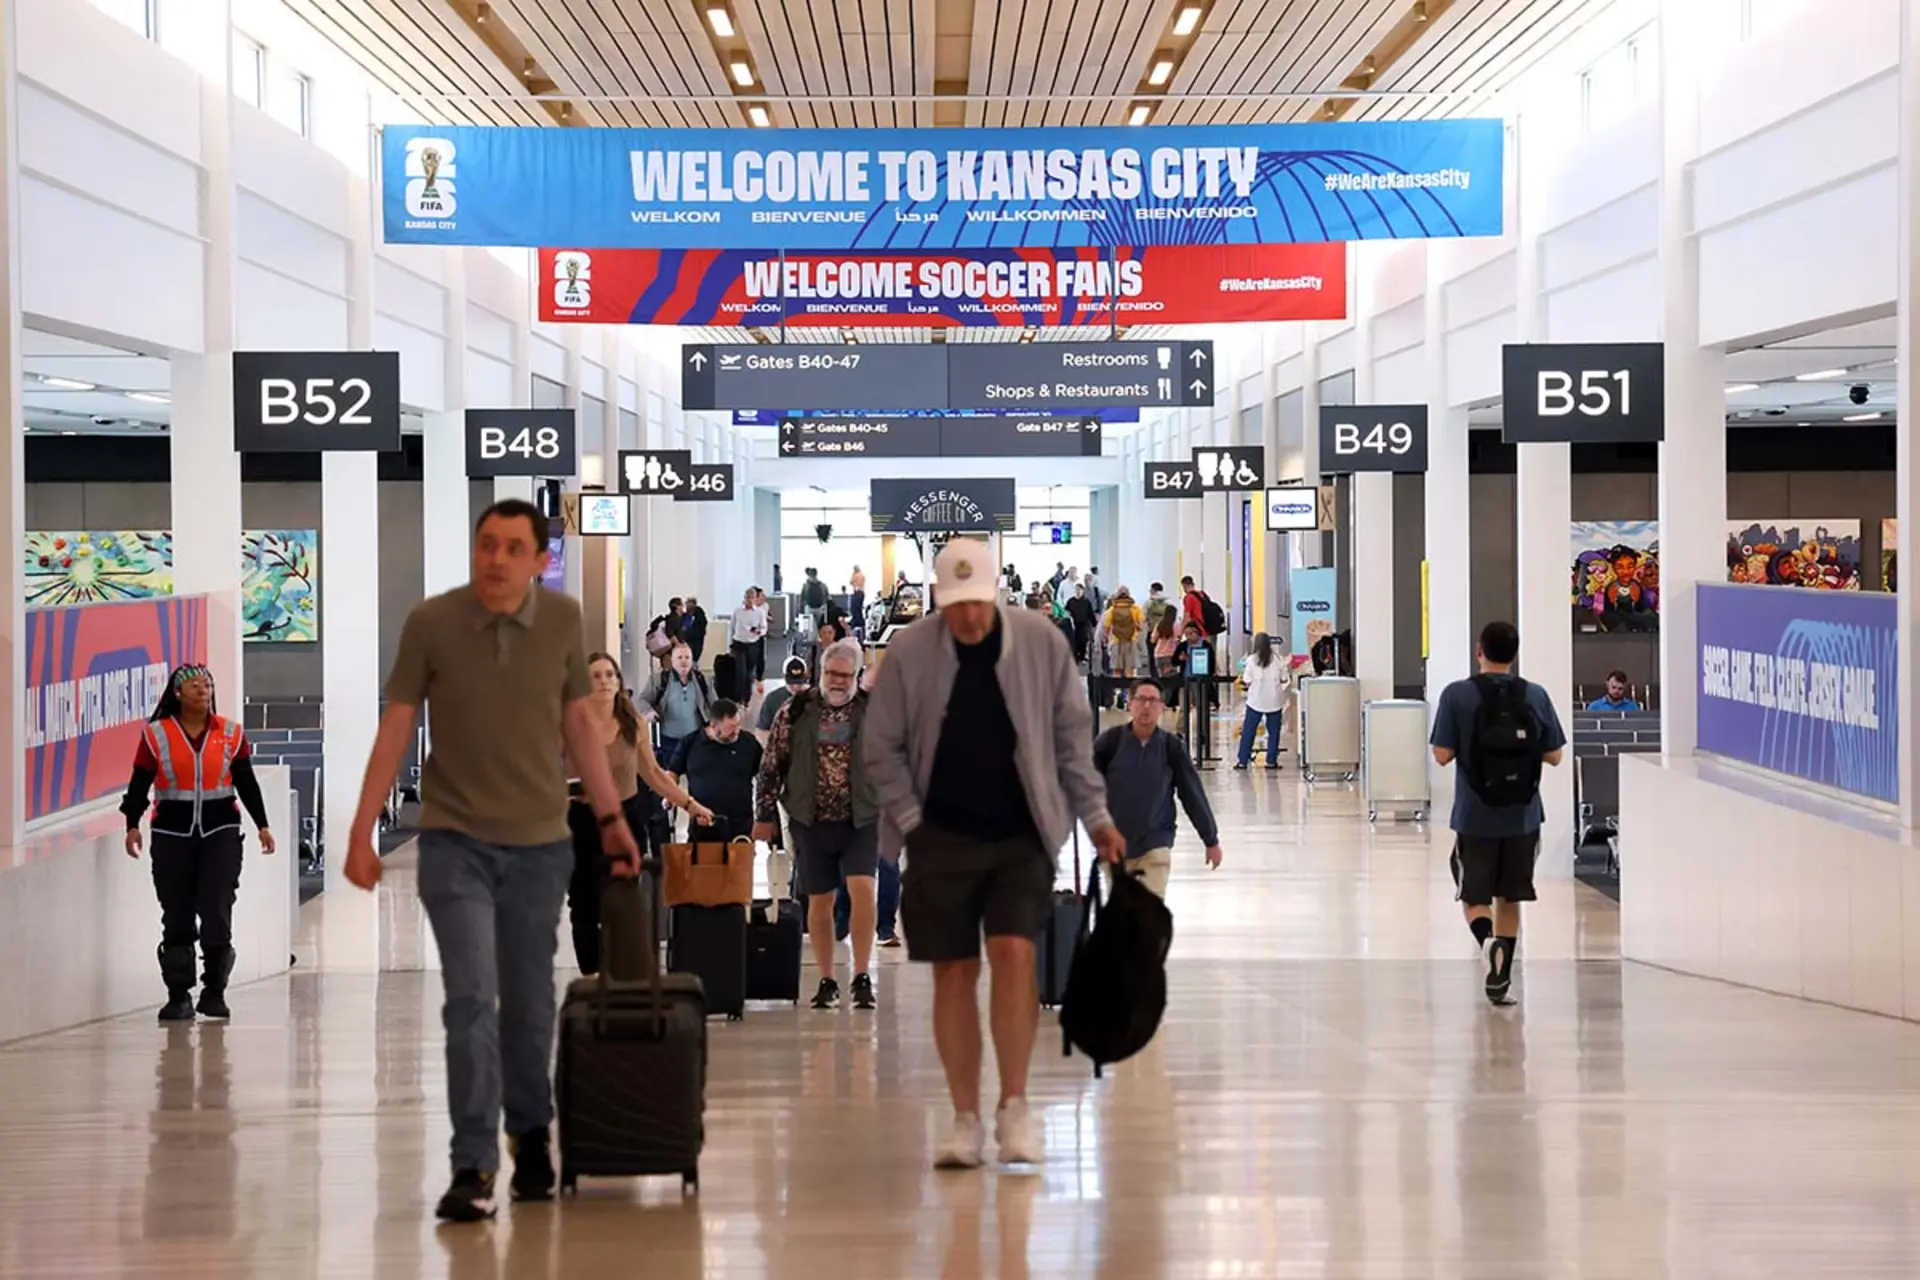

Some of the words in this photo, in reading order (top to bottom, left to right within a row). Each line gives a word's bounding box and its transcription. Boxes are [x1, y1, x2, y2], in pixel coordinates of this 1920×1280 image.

[630, 151, 870, 202] WELCOME
[879, 151, 937, 202] TO
[947, 149, 1142, 201] KANSAS
[1151, 147, 1259, 199] CITY
[1324, 168, 1471, 191] #WeAreKansasCity
[420, 201, 443, 211] FIFA
[966, 209, 1107, 222] WILLKOMMEN
[1135, 207, 1258, 220] BIENVENIDO
[631, 211, 721, 223] WELKOM
[752, 211, 866, 223] BIENVENUE
[743, 262, 913, 298] WELCOME
[919, 261, 1050, 298] SOCCER
[1057, 260, 1143, 297] FANS
[1219, 275, 1323, 292] #WeAreKansasCity
[806, 303, 887, 313] BIENVENUE
[958, 303, 1057, 313] WILLKOMMEN
[1077, 301, 1164, 312] BIENVENIDO
[746, 355, 794, 369] Gates
[799, 355, 860, 369] B40-47
[1063, 352, 1149, 367] Restrooms
[985, 384, 1035, 400] Shops
[1039, 383, 1051, 398] &
[1055, 383, 1149, 397] Restaurants
[1538, 369, 1630, 416] B51
[261, 378, 372, 425] B52
[817, 423, 847, 433] Gates
[849, 423, 888, 433] B40-45
[1016, 422, 1041, 433] Gate
[1043, 422, 1064, 433] B47
[481, 427, 559, 459] B48
[1335, 422, 1412, 454] B49
[817, 441, 842, 453] Gate
[690, 473, 726, 492] 46
[1153, 471, 1194, 490] B47
[903, 490, 985, 525] MESSENGER
[922, 502, 952, 524] COFFEE
